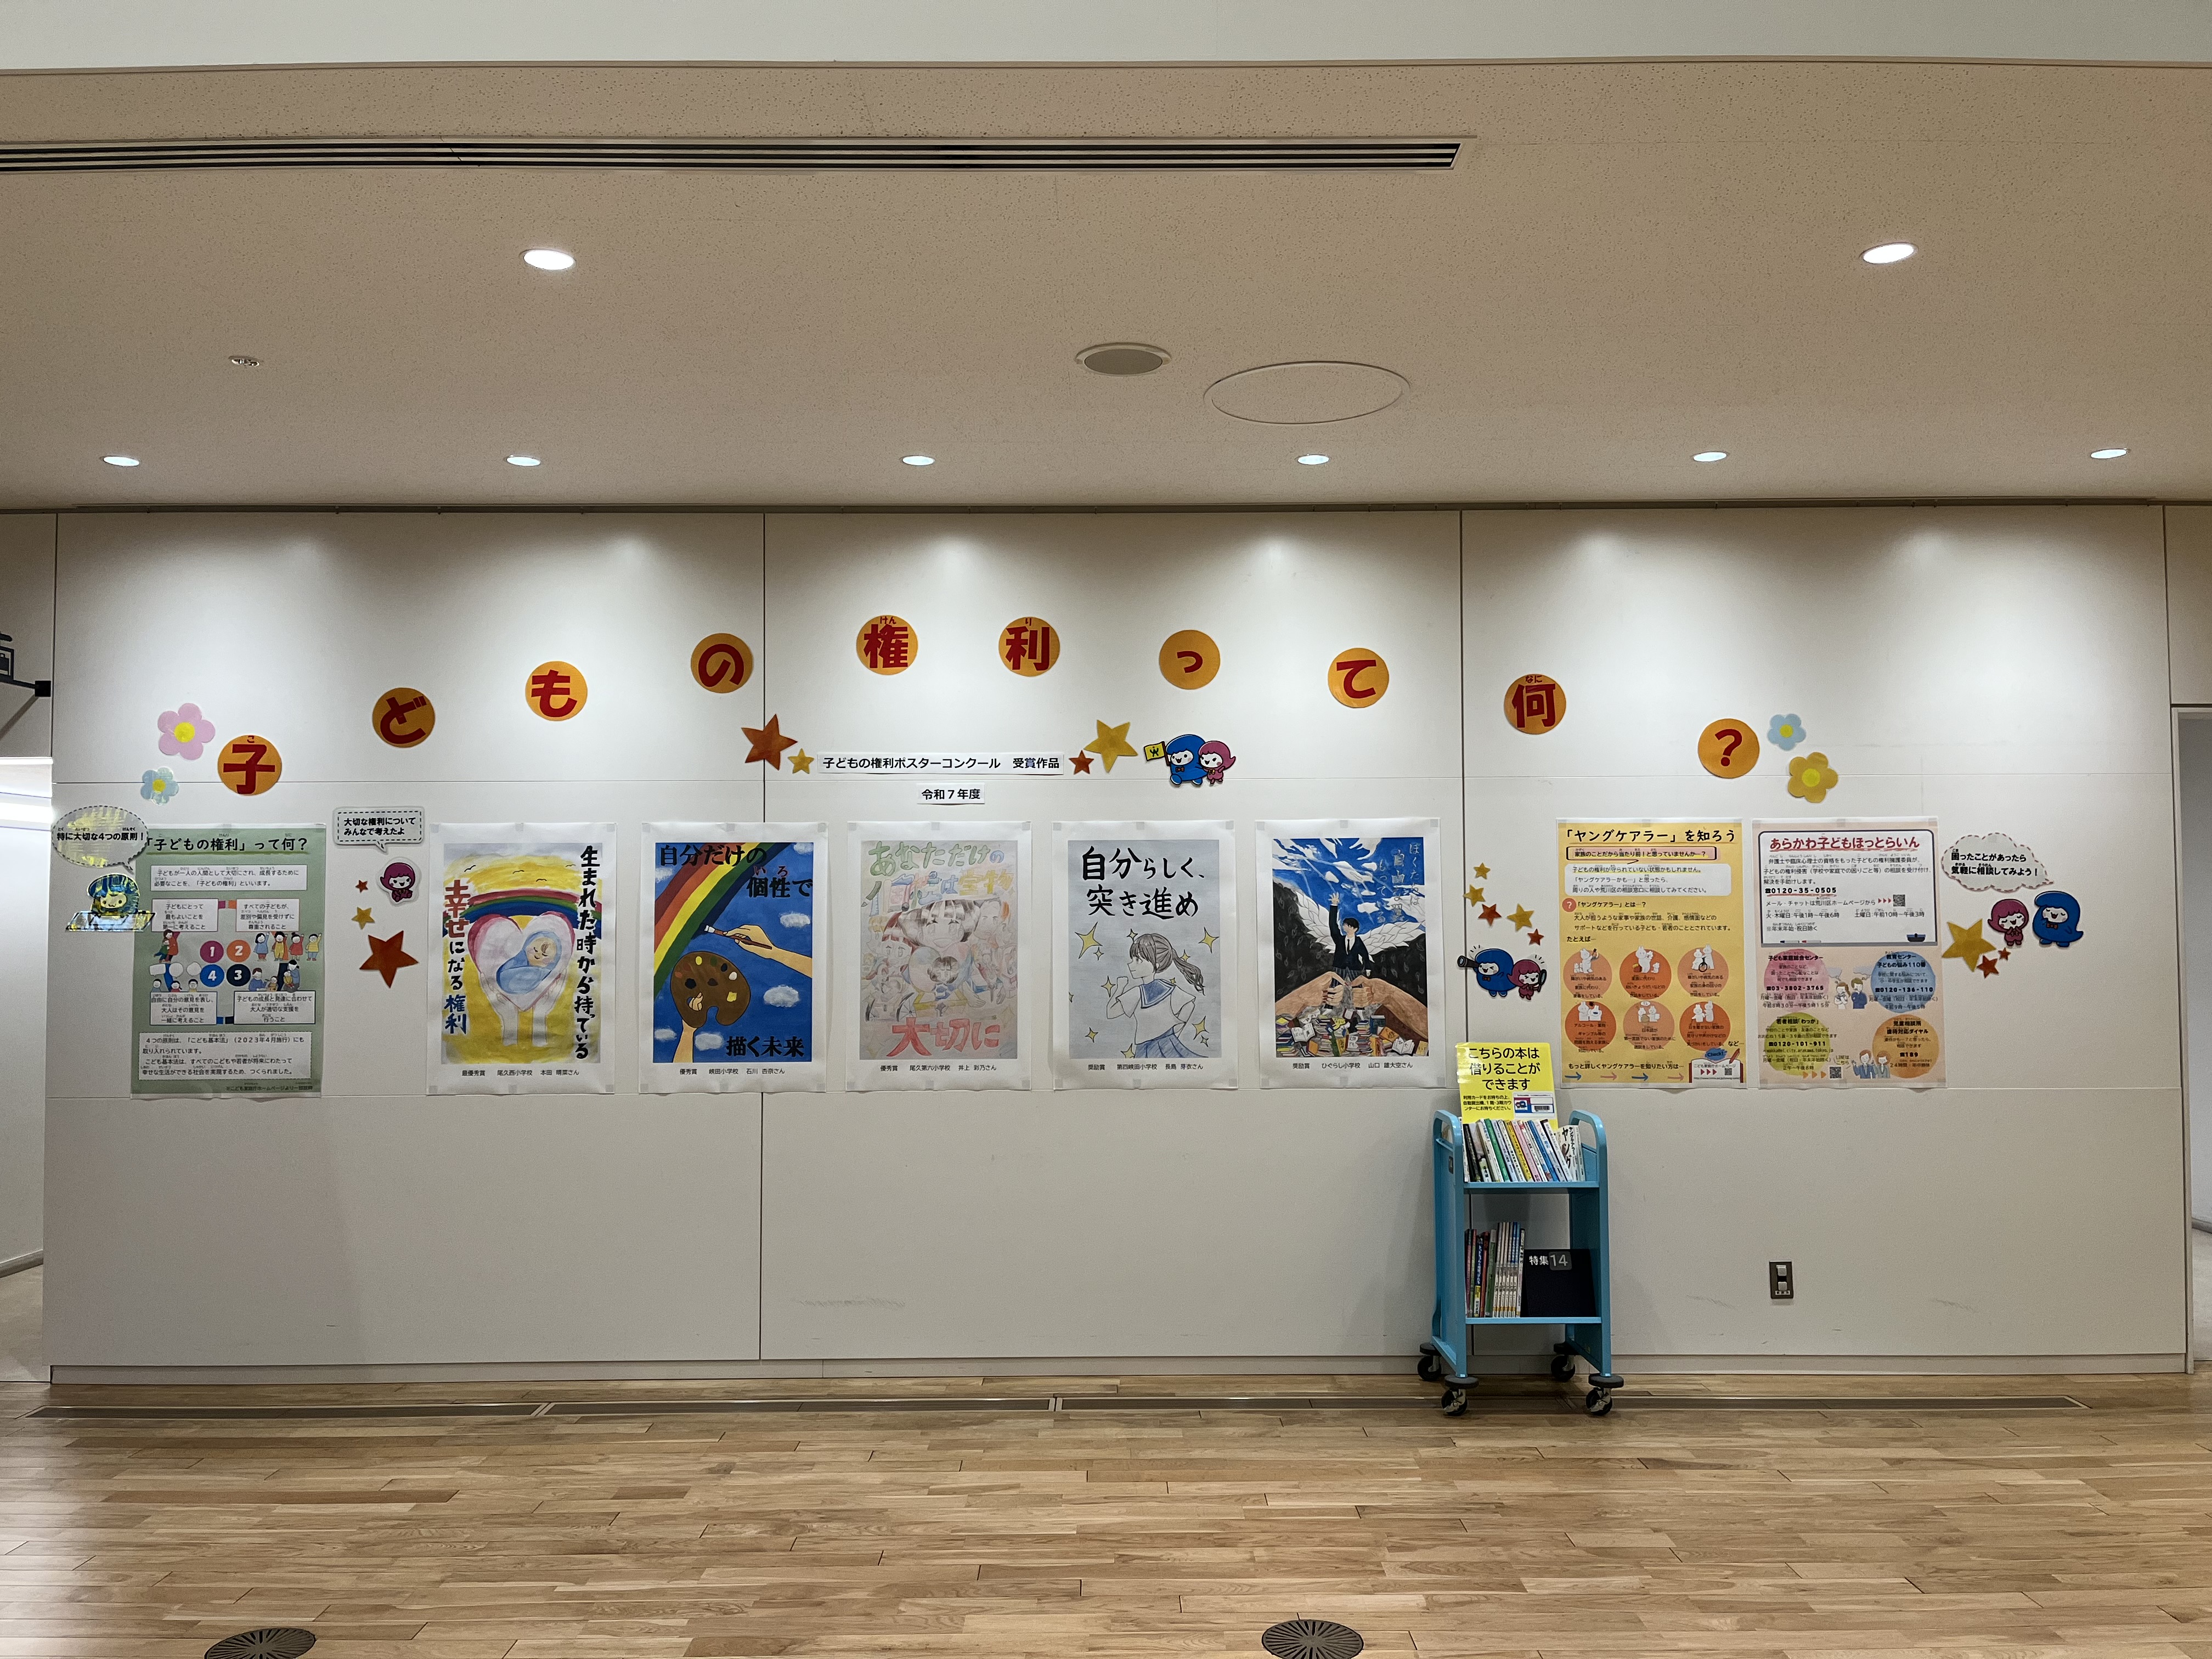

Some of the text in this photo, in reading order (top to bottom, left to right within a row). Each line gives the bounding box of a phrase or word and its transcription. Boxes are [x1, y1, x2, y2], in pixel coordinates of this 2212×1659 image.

[223, 743, 275, 794] 子
[380, 695, 427, 744] ど
[531, 669, 578, 718] も
[698, 644, 744, 687] の
[864, 624, 908, 669] 権
[1005, 625, 1050, 670] 利
[1335, 659, 1376, 699] て
[1511, 684, 1556, 727] 何
[1714, 729, 1743, 767] ？
[823, 757, 1060, 769] 子どもの権利ポスターコンクール 受賞作品
[922, 789, 980, 800] 令和７年度
[344, 817, 415, 826] 大切な権利について
[344, 827, 405, 836] みんなで考えたよ
[1566, 829, 1735, 842] 「ヤングケアラー」を知ろう
[147, 838, 307, 850] 「子どもの権利」って何？
[1770, 837, 1920, 849] あらかわ子どもほっとらいん
[659, 844, 767, 867] 自分だけの
[868, 841, 1005, 876] あなただけの
[1951, 853, 2027, 862] 困ったことがあったら
[1081, 845, 1205, 882] 自分らしく、
[1951, 866, 2038, 876] 気軽に相談してみよう！
[746, 877, 813, 899] 個性で
[861, 870, 1015, 917] 個性は宝物
[1086, 884, 1199, 919] 突き進め
[210, 947, 215, 956] 1
[235, 946, 242, 956] 2
[444, 879, 471, 1035] 幸せになる権利
[574, 845, 600, 1059] 生まれた時から持っている
[207, 970, 217, 980] 4
[234, 970, 242, 980] 3
[886, 1017, 1000, 1058] 大切に
[726, 1036, 805, 1057] 描く未来
[1469, 1047, 1540, 1059] こちらの本は
[1470, 1063, 1541, 1075] 借りることが
[1482, 1079, 1531, 1090] できます
[1529, 1254, 1568, 1267] 特集 14
